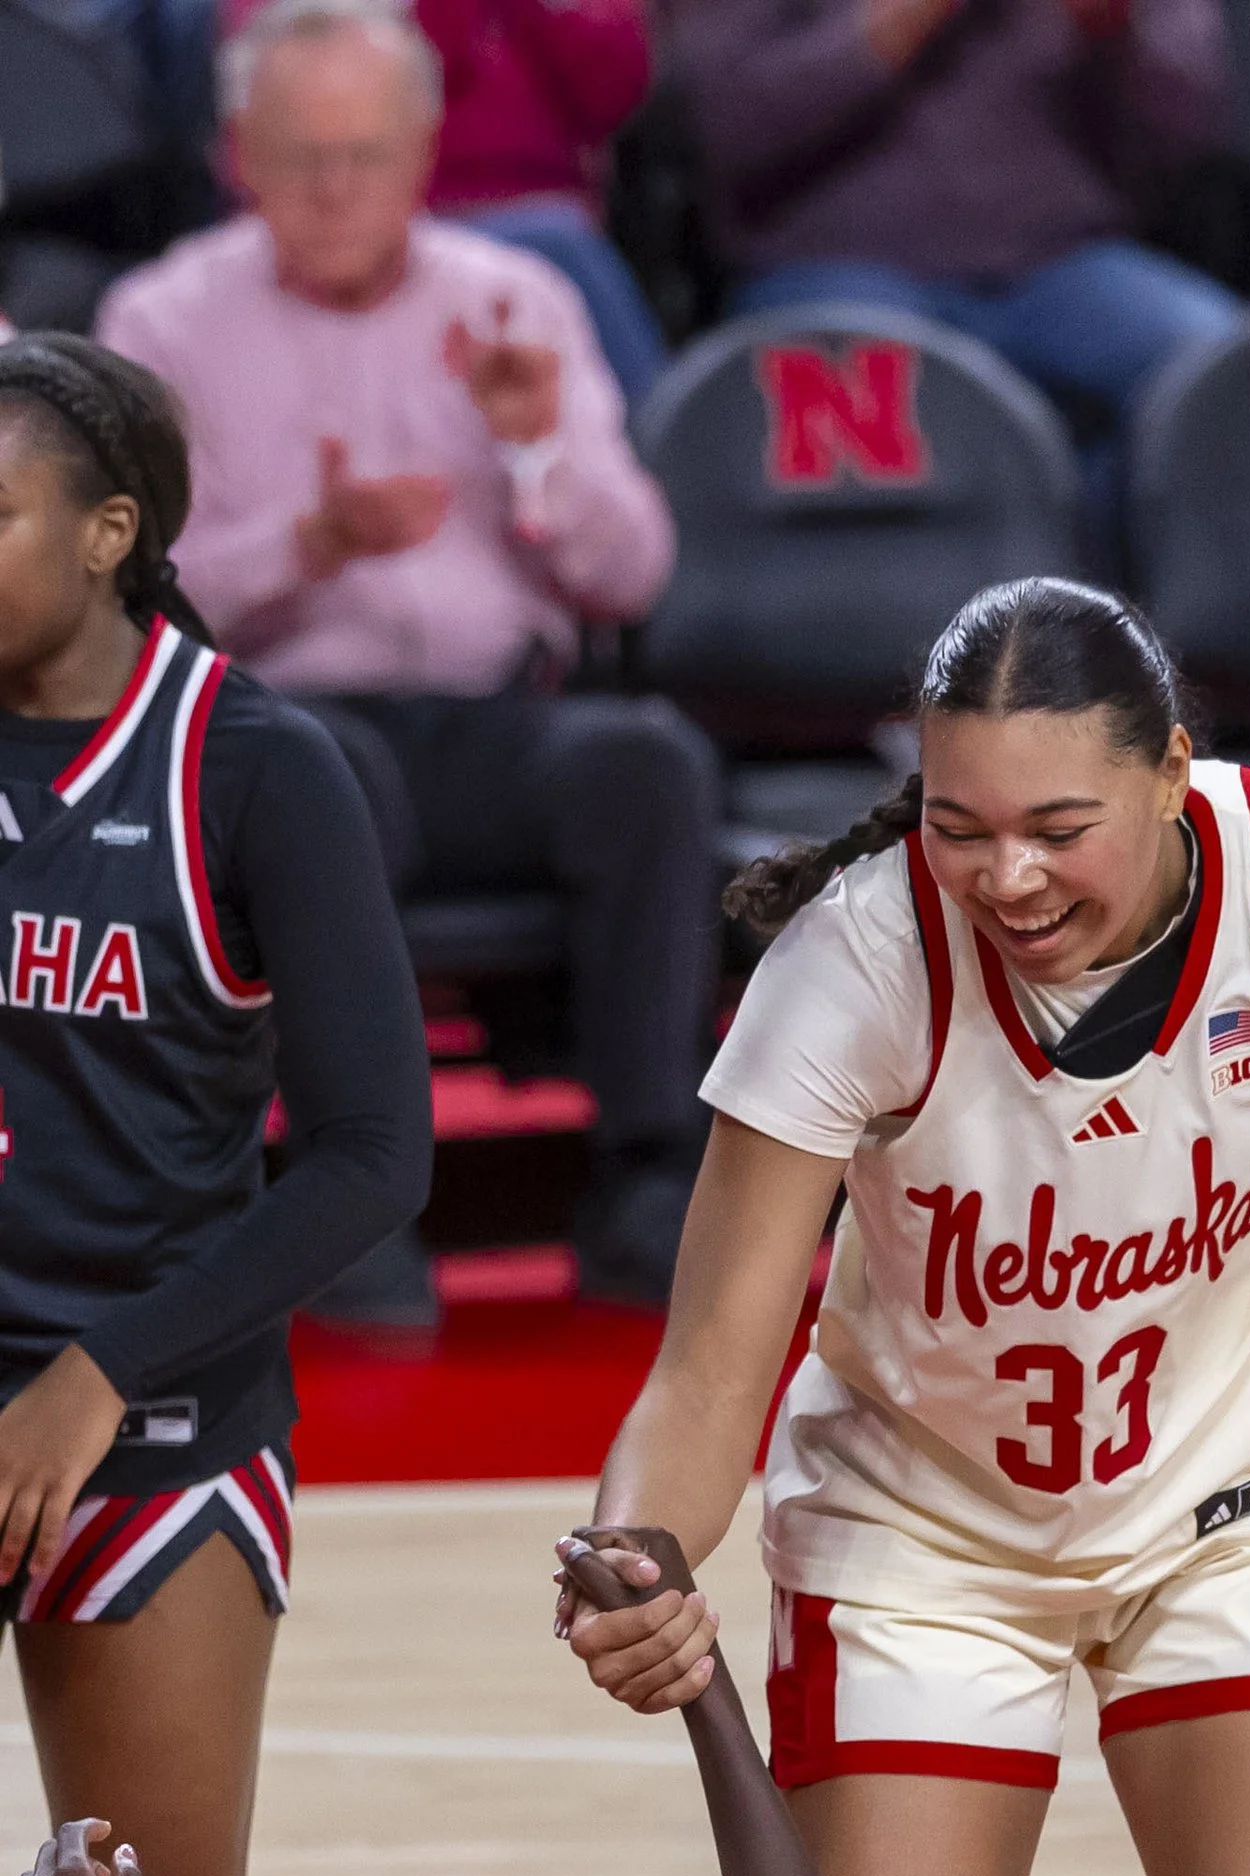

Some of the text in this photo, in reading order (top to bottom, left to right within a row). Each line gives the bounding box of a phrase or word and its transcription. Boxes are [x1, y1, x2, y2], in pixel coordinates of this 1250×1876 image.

[760, 339, 930, 488] N
[0, 911, 149, 1020] HA
[995, 1325, 1168, 1495] 33
